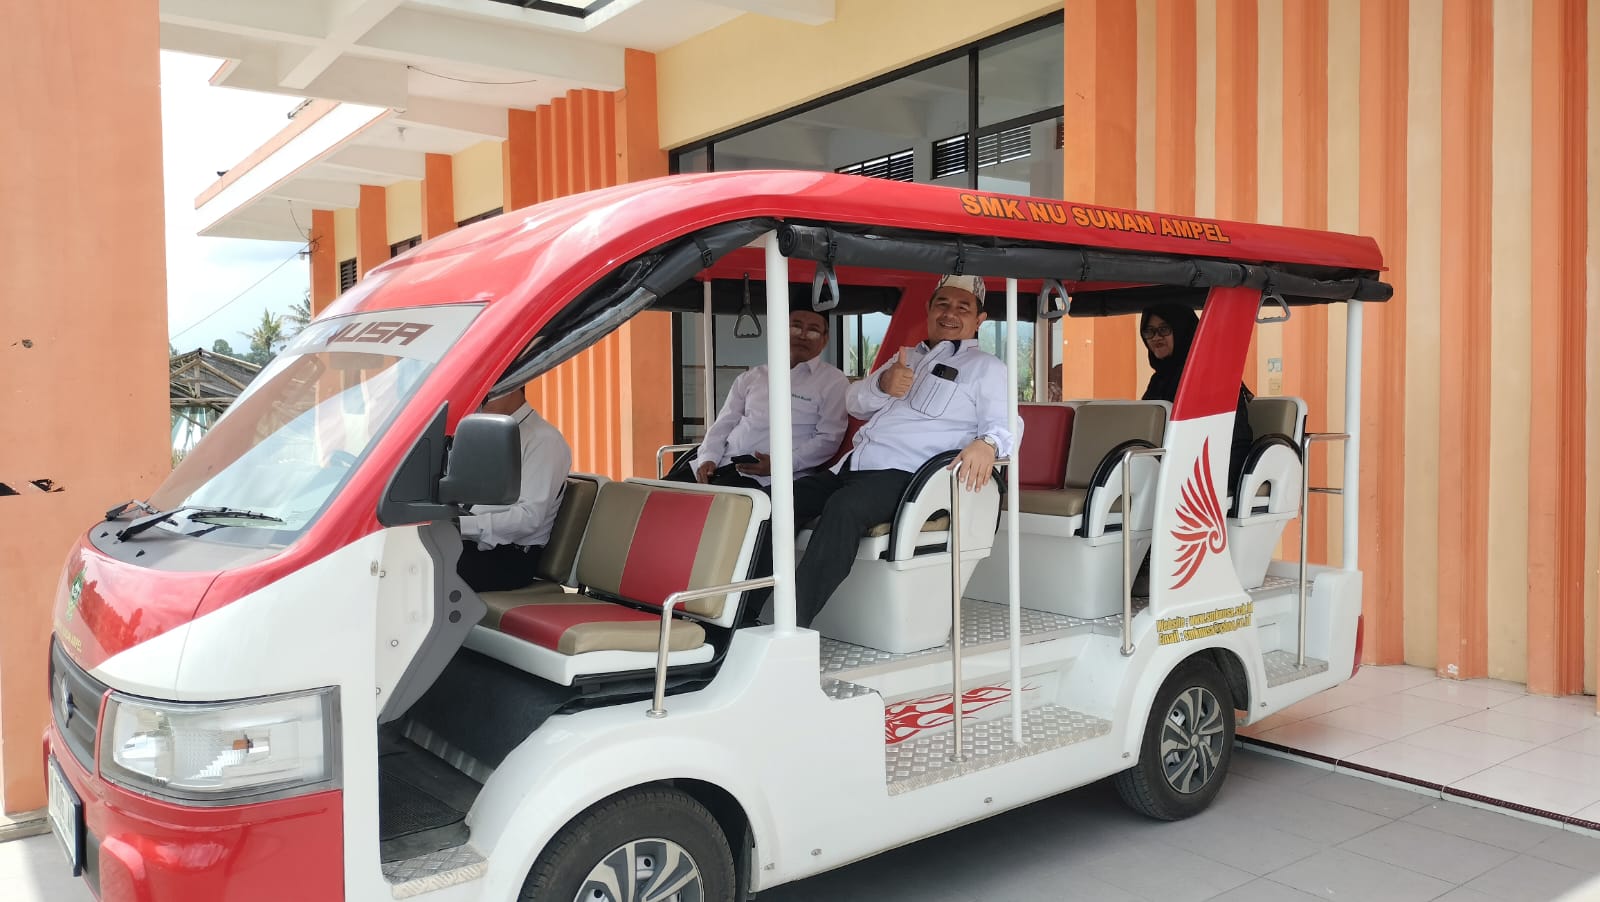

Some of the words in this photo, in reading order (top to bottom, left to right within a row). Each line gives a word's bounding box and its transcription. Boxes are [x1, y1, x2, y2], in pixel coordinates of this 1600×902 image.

[960, 193, 1027, 221] SMK
[1027, 200, 1068, 225] NU
[1071, 206, 1156, 234] SUNAN
[1160, 217, 1232, 243] AMPEL
[1156, 616, 1185, 633] Website
[1159, 630, 1181, 645] Email
